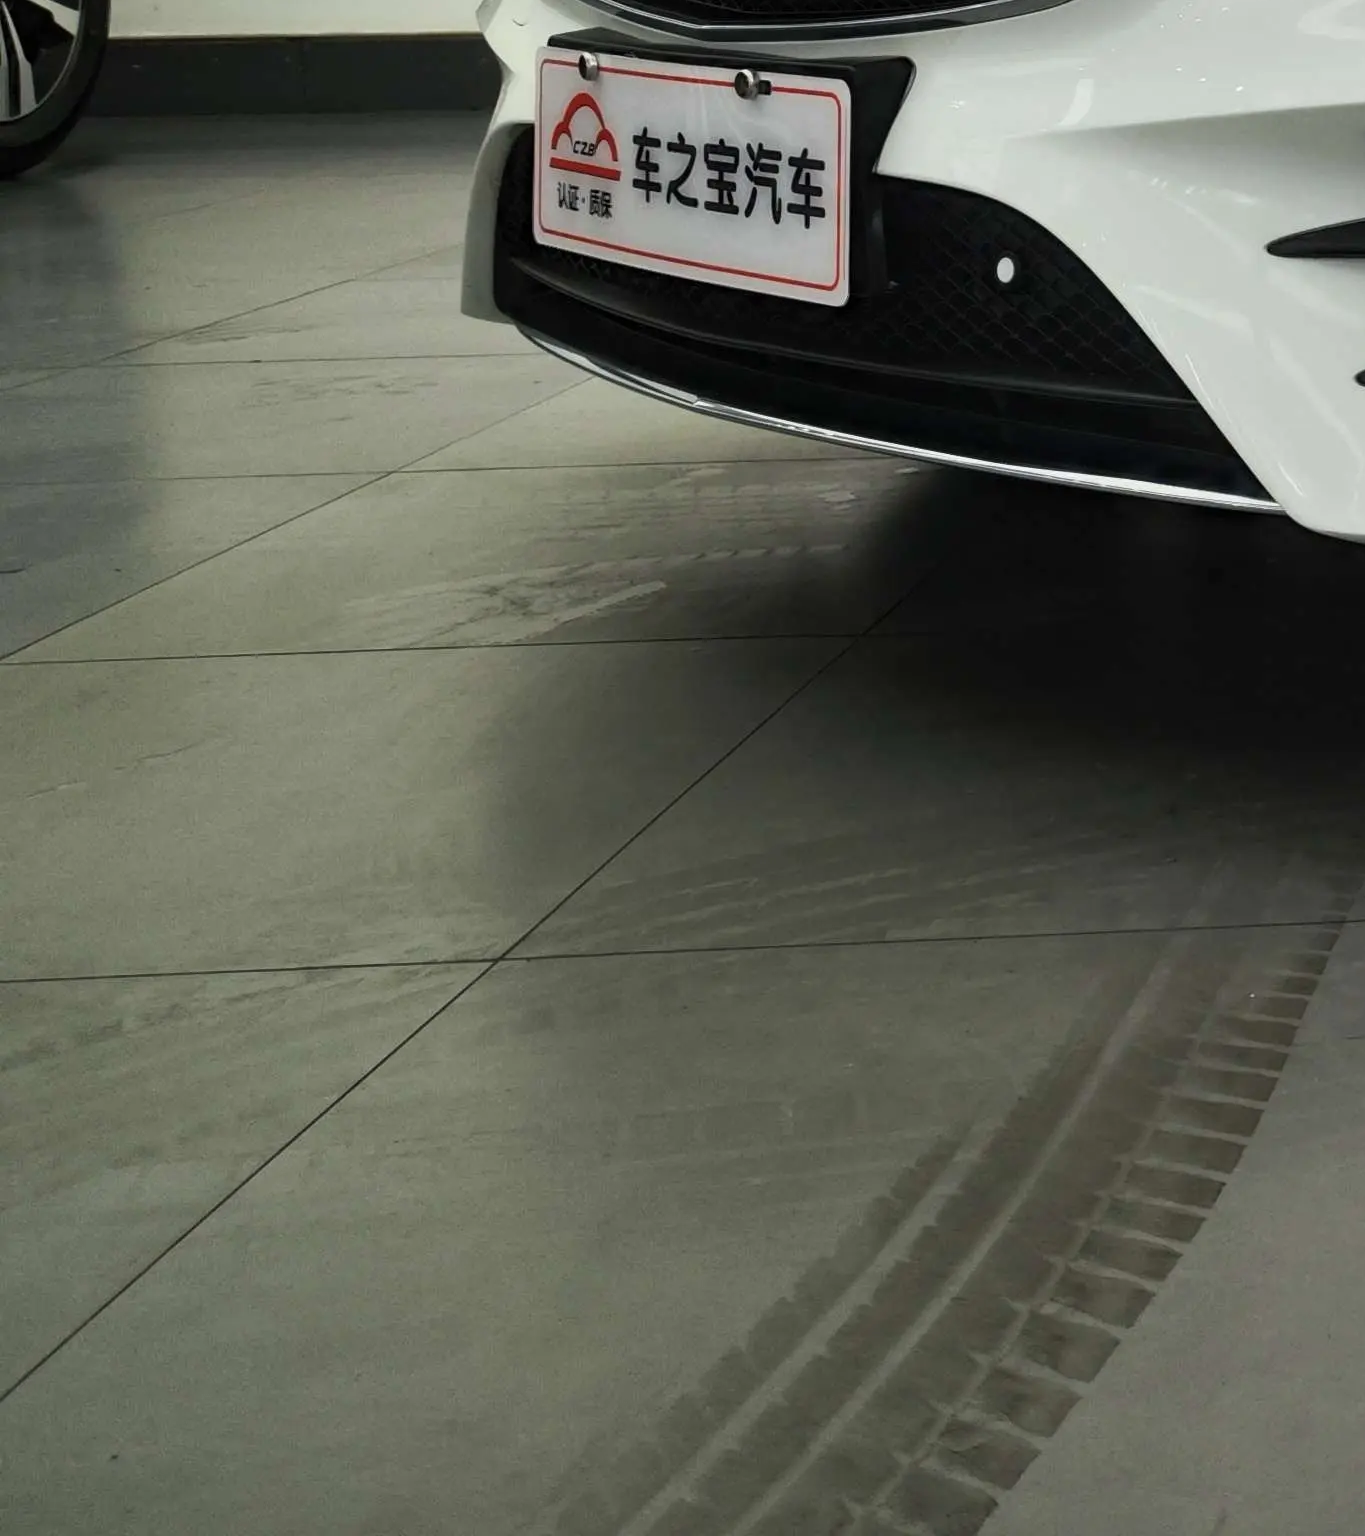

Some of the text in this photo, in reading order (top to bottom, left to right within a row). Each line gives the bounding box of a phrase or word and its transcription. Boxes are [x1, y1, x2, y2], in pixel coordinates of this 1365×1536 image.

[573, 140, 597, 157] CZB
[632, 126, 826, 230] 车之宝汽车
